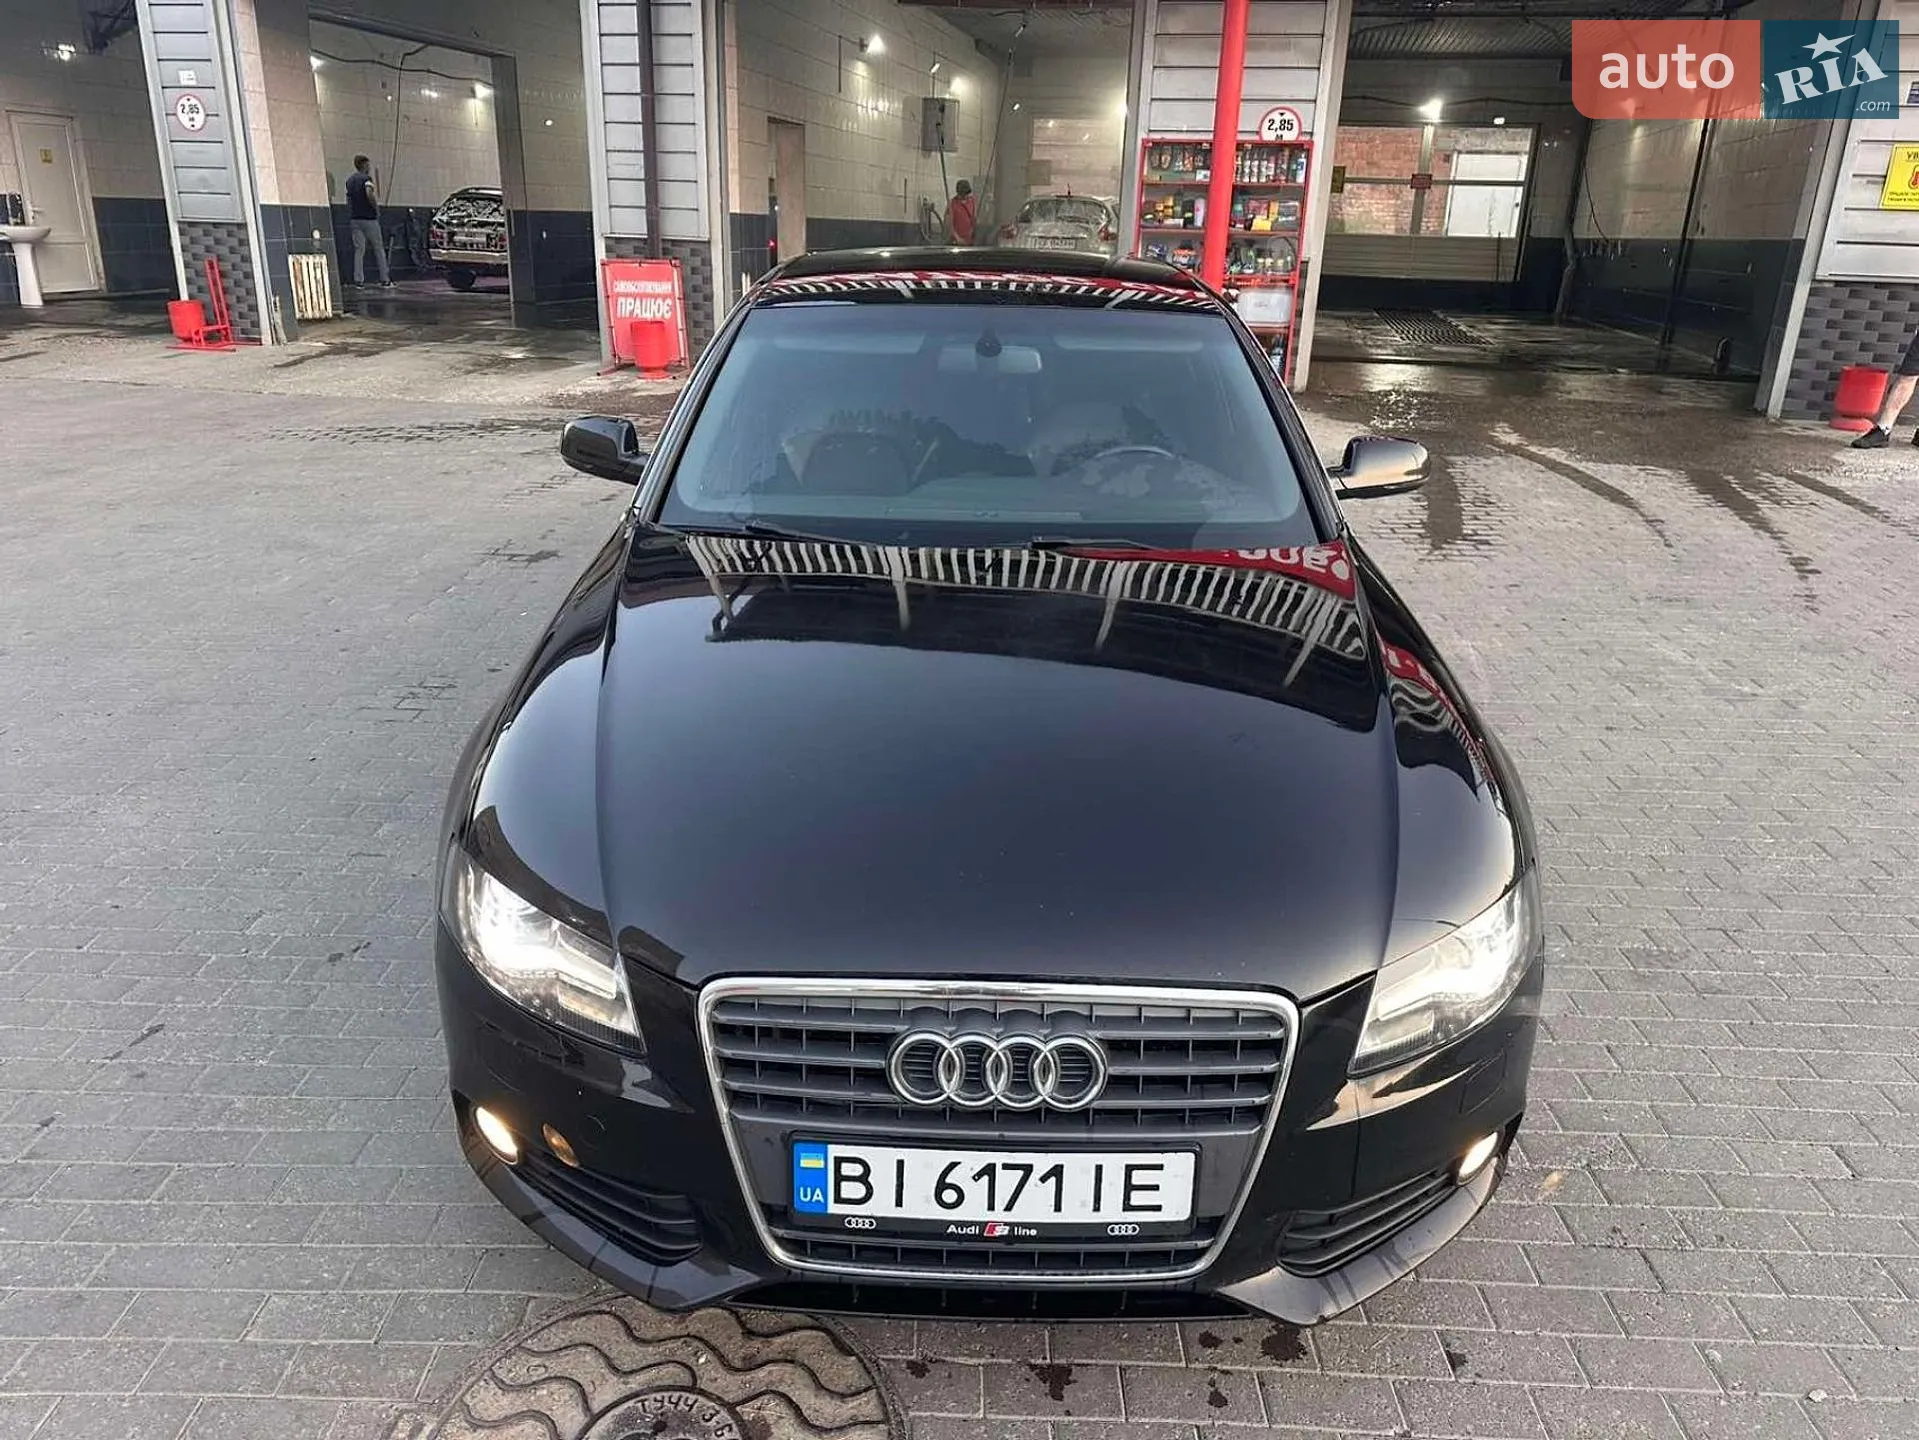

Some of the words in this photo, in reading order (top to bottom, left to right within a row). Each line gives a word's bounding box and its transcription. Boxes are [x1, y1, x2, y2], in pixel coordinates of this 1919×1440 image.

[1268, 118, 1294, 132] 2,85
[617, 297, 673, 320] ПРАЦЮЄ
[799, 1187, 825, 1203] UA
[934, 1161, 1065, 1213] 6171
[946, 1224, 980, 1235] Audi
[1014, 1226, 1038, 1236] line
